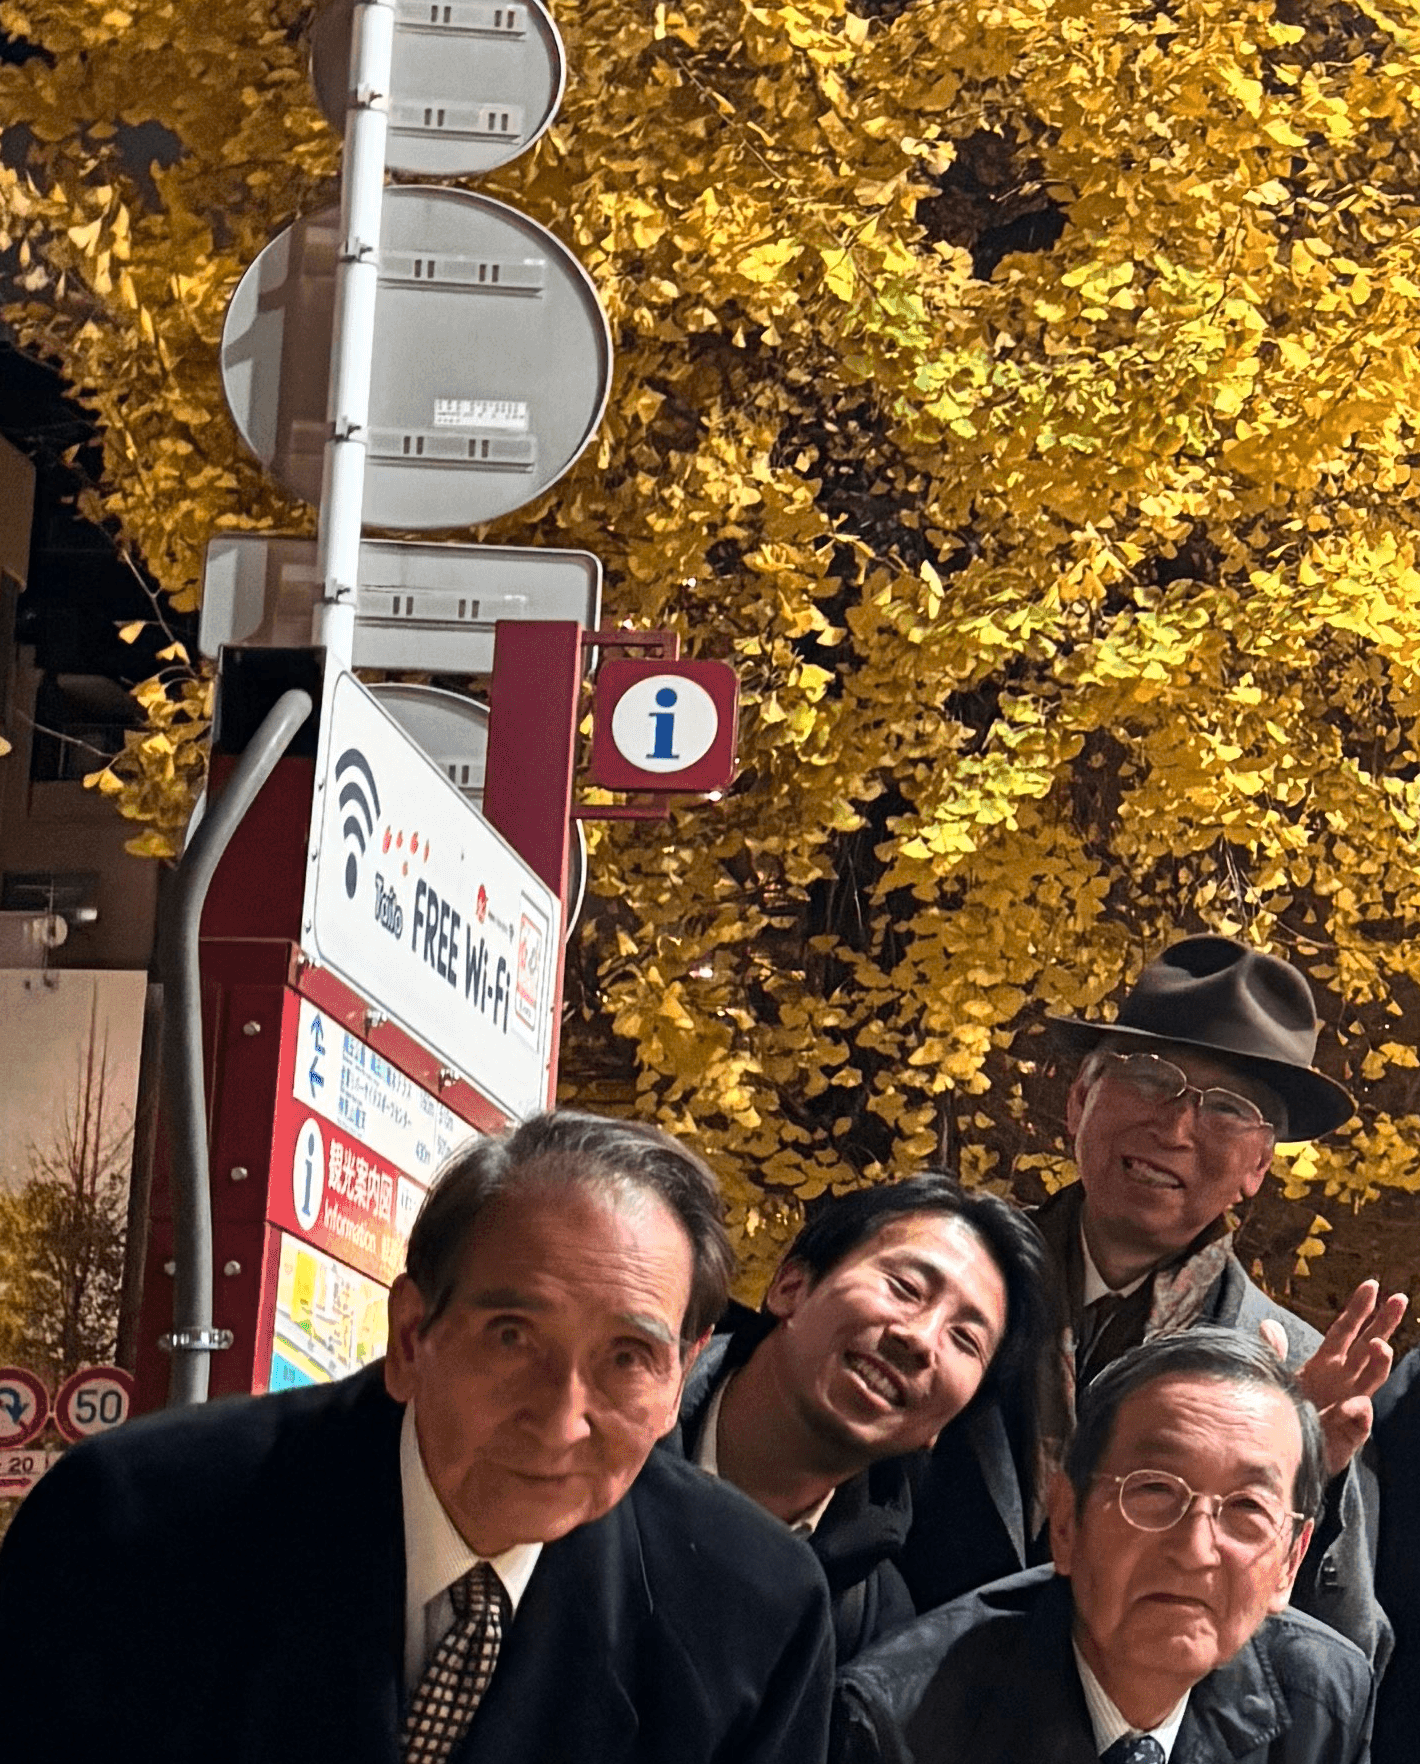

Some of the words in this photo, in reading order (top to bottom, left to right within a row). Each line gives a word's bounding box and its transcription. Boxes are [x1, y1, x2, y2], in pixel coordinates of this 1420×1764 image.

[411, 877, 461, 988] FREE
[465, 921, 511, 1035] Wi-Fi
[324, 1198, 378, 1254] Information
[75, 1389, 122, 1424] 50
[8, 1456, 35, 1475] 20
